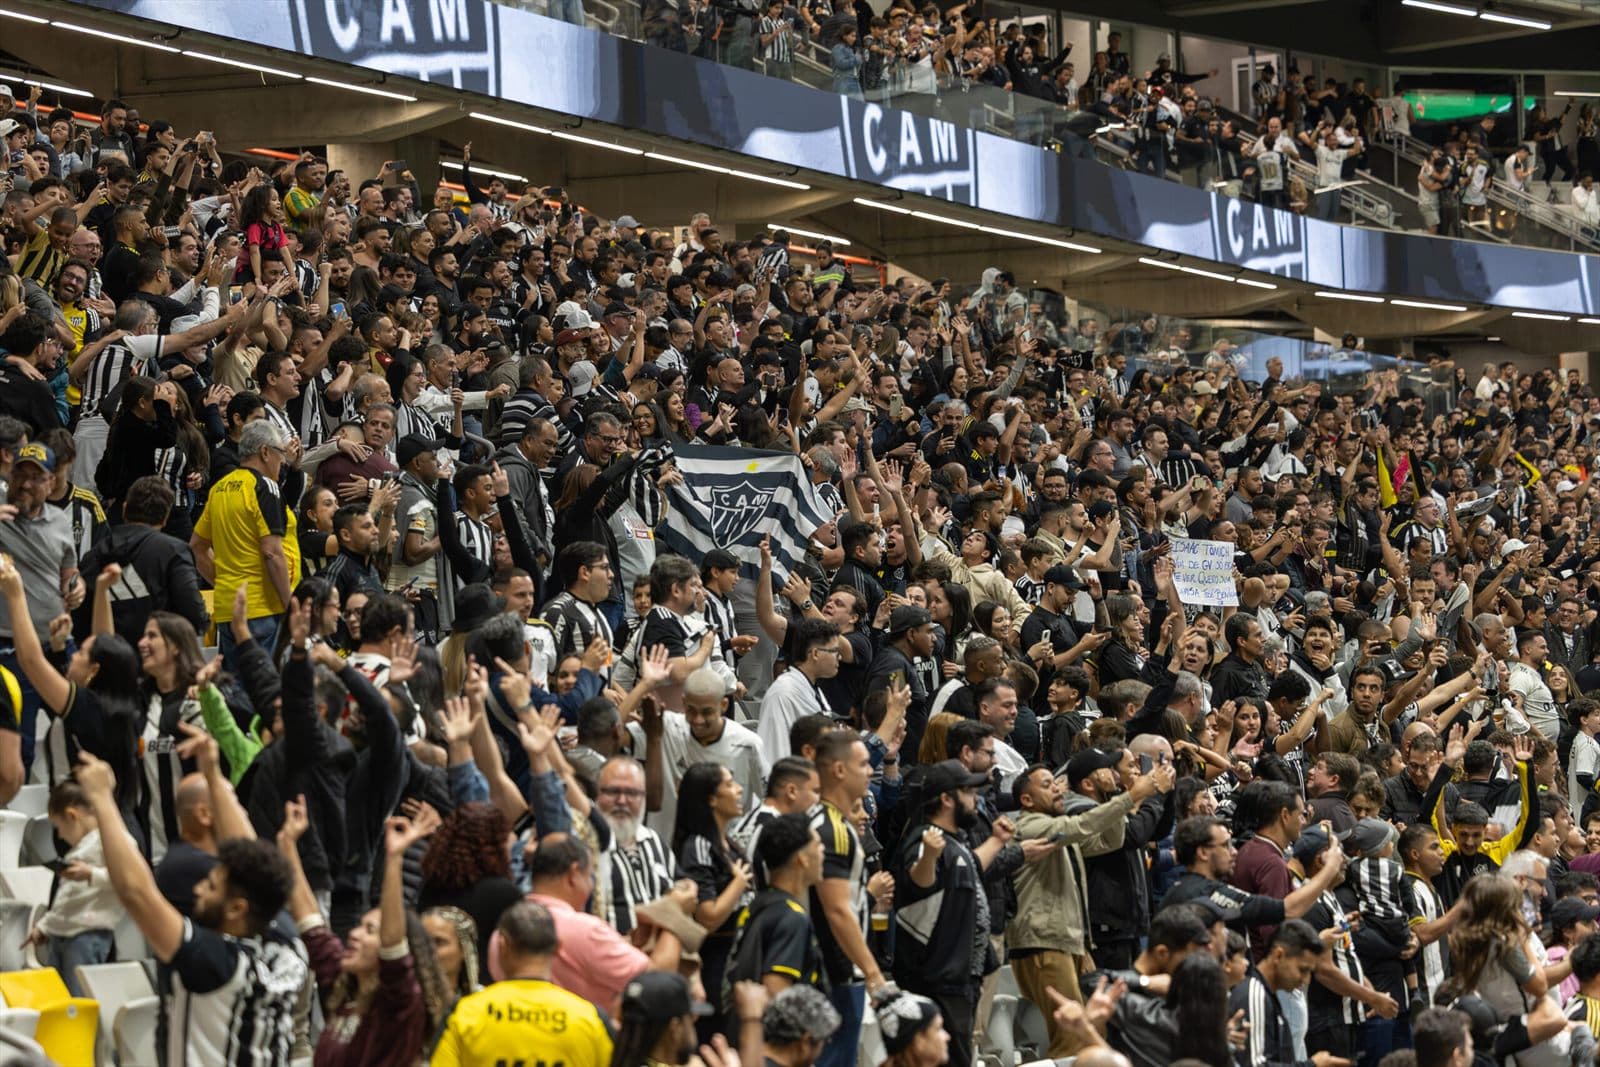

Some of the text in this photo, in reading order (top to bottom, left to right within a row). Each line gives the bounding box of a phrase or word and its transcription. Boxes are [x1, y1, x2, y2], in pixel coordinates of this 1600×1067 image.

[324, 0, 470, 52] CAM
[863, 102, 958, 175] CAM
[1227, 198, 1294, 258] CAM
[721, 493, 768, 507] CAM
[508, 1003, 567, 1033] bmg
